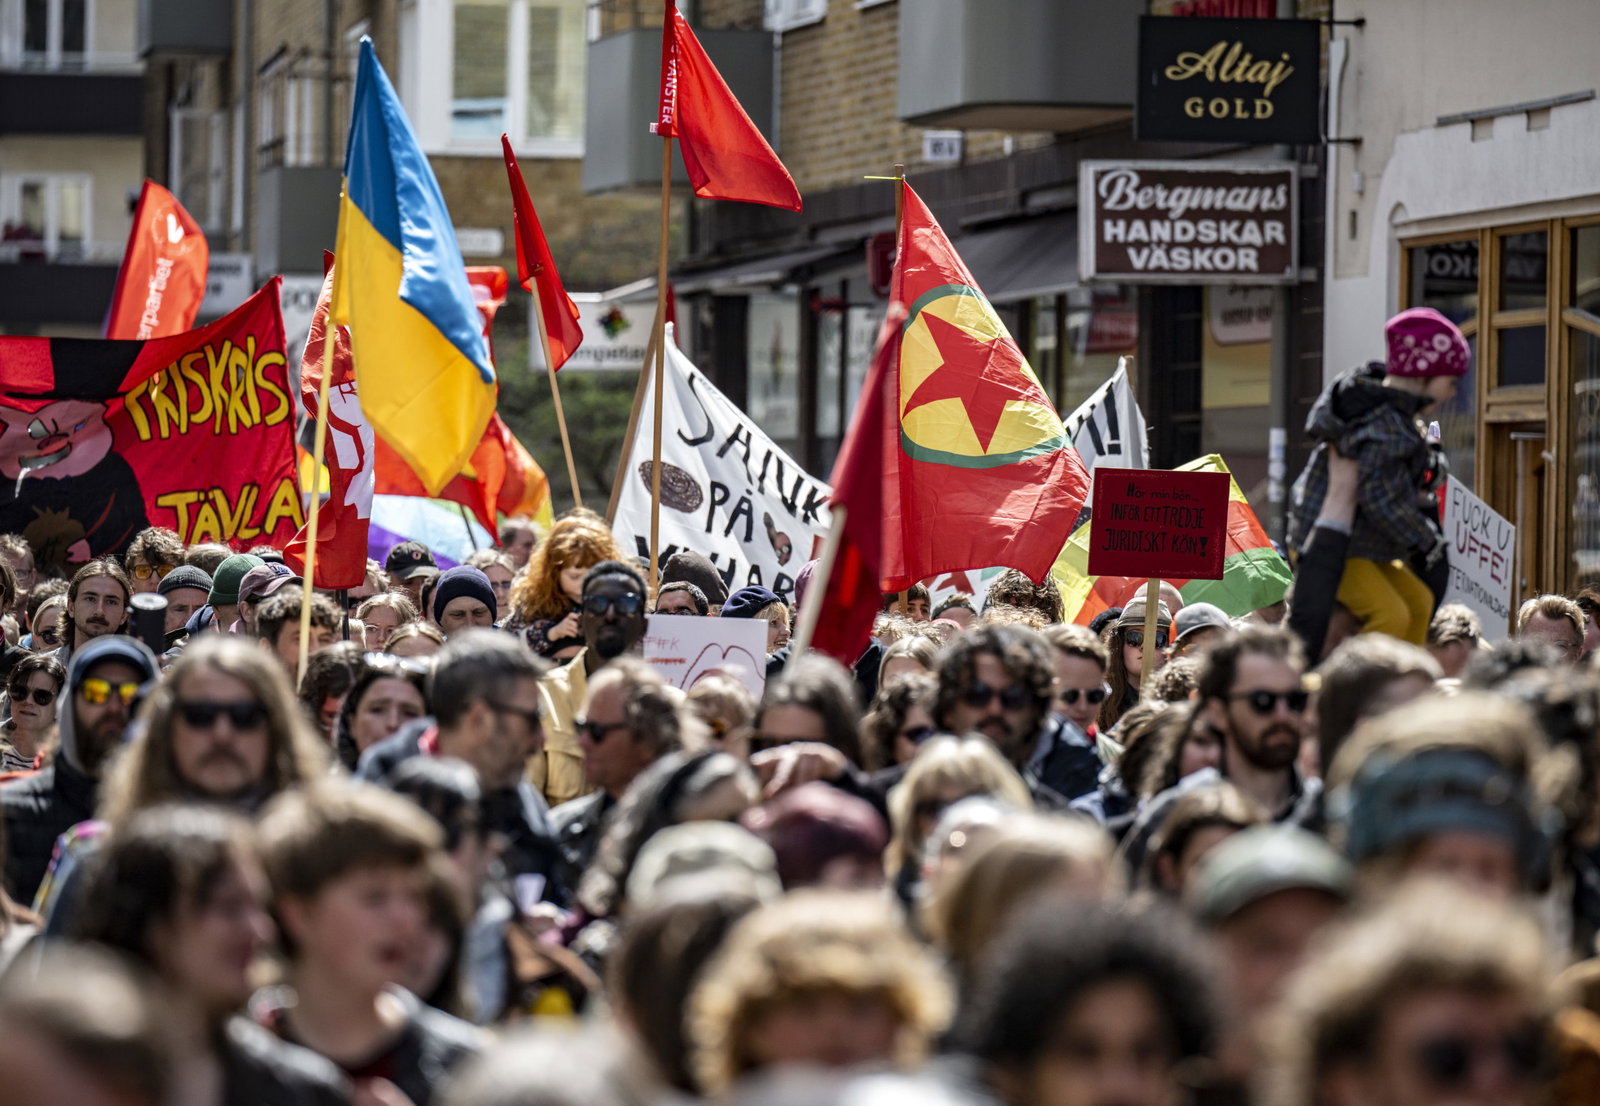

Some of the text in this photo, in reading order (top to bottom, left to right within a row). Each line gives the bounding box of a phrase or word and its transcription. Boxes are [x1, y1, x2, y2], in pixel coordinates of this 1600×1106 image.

[1165, 41, 1295, 97] Altaj
[1184, 97, 1274, 119] GOLD
[1098, 169, 1288, 219] Bergmans
[1103, 219, 1286, 247] HANDSKAR
[1127, 244, 1259, 271] VÄSKOR
[1451, 487, 1511, 551] FUCK U
[1102, 528, 1167, 552] JURIDISKT
[1455, 520, 1509, 591] UFFE!
